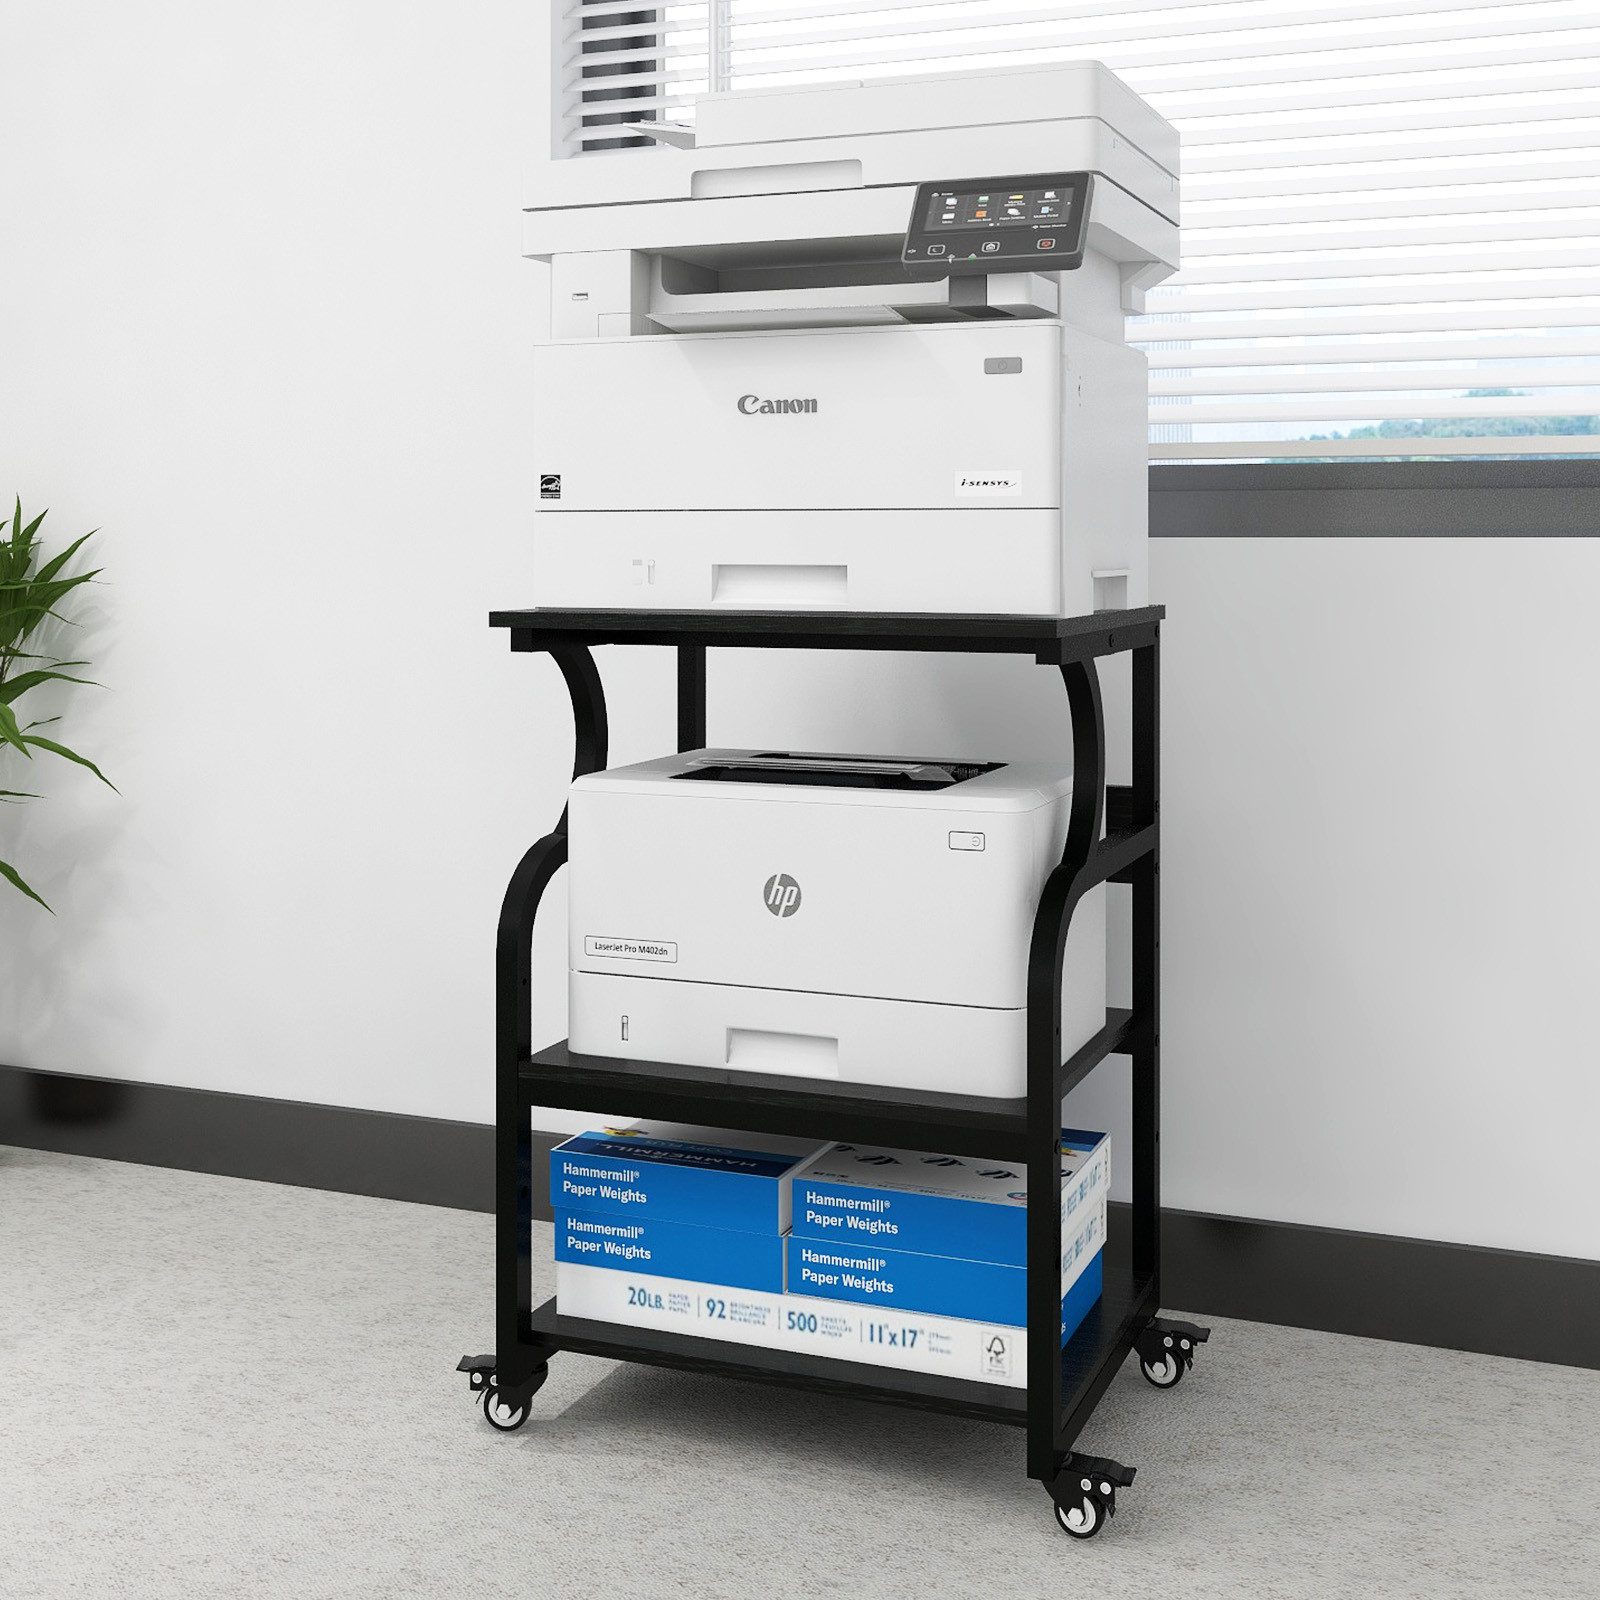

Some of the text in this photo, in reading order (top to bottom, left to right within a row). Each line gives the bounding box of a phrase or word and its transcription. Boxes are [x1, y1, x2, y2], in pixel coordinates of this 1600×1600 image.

[737, 394, 818, 415] Canon
[766, 873, 800, 917] hp
[595, 942, 668, 955] LaserJet Pro M402dn
[563, 1181, 647, 1204] Paper Weights
[806, 1210, 898, 1234] Paper Weights
[567, 1236, 651, 1260] Paper Weights
[802, 1268, 894, 1293] Paper Weights
[706, 1298, 726, 1319] 92
[787, 1311, 818, 1333] 500
